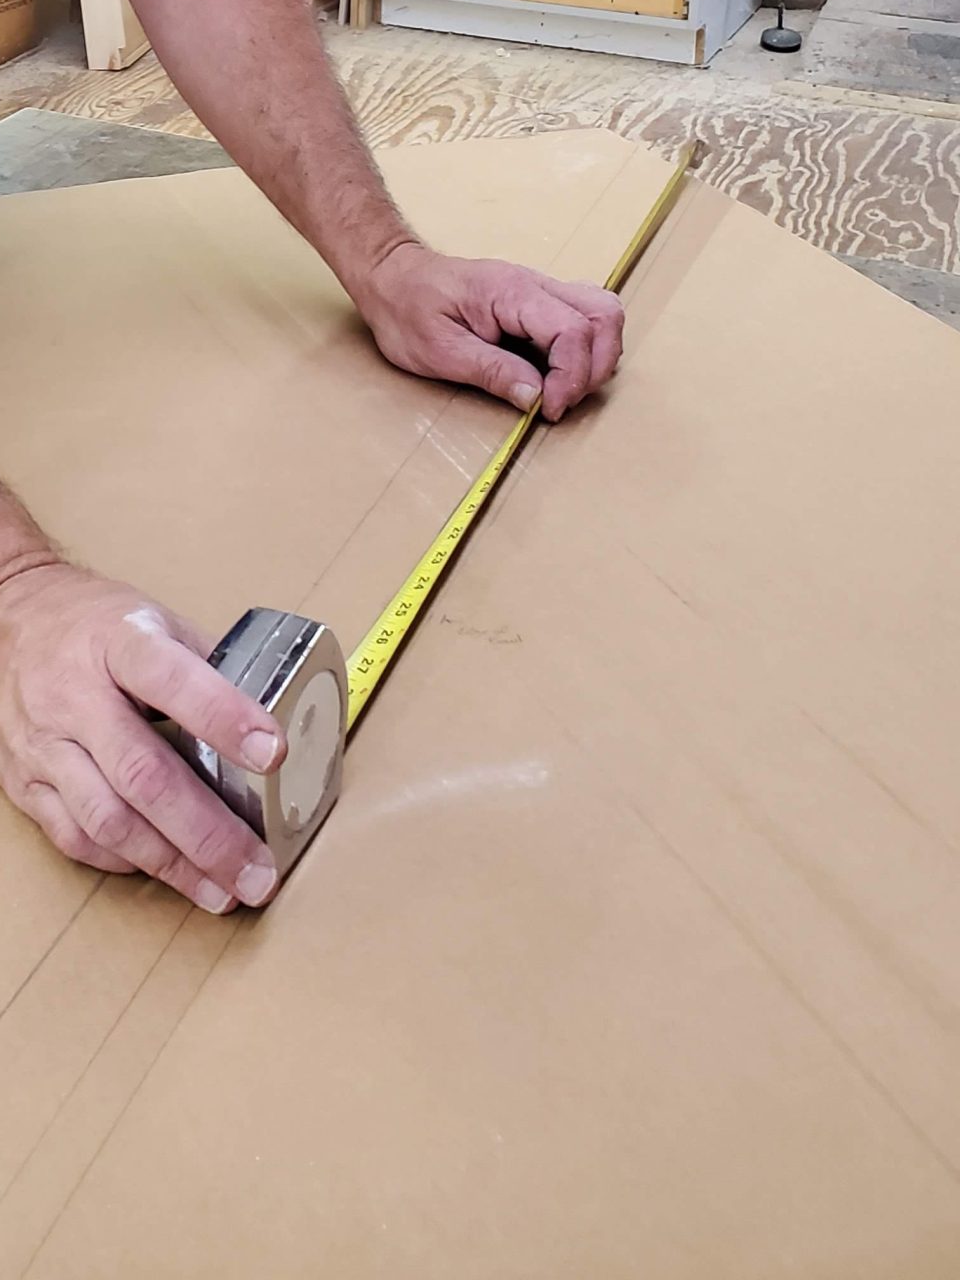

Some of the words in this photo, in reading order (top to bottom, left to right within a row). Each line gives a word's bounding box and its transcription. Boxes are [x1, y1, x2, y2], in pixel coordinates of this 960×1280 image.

[447, 526, 463, 540] 22
[431, 551, 447, 565] 23
[413, 576, 430, 590] 24
[395, 602, 412, 617] 25
[376, 629, 394, 645] 26
[356, 657, 374, 674] 27
